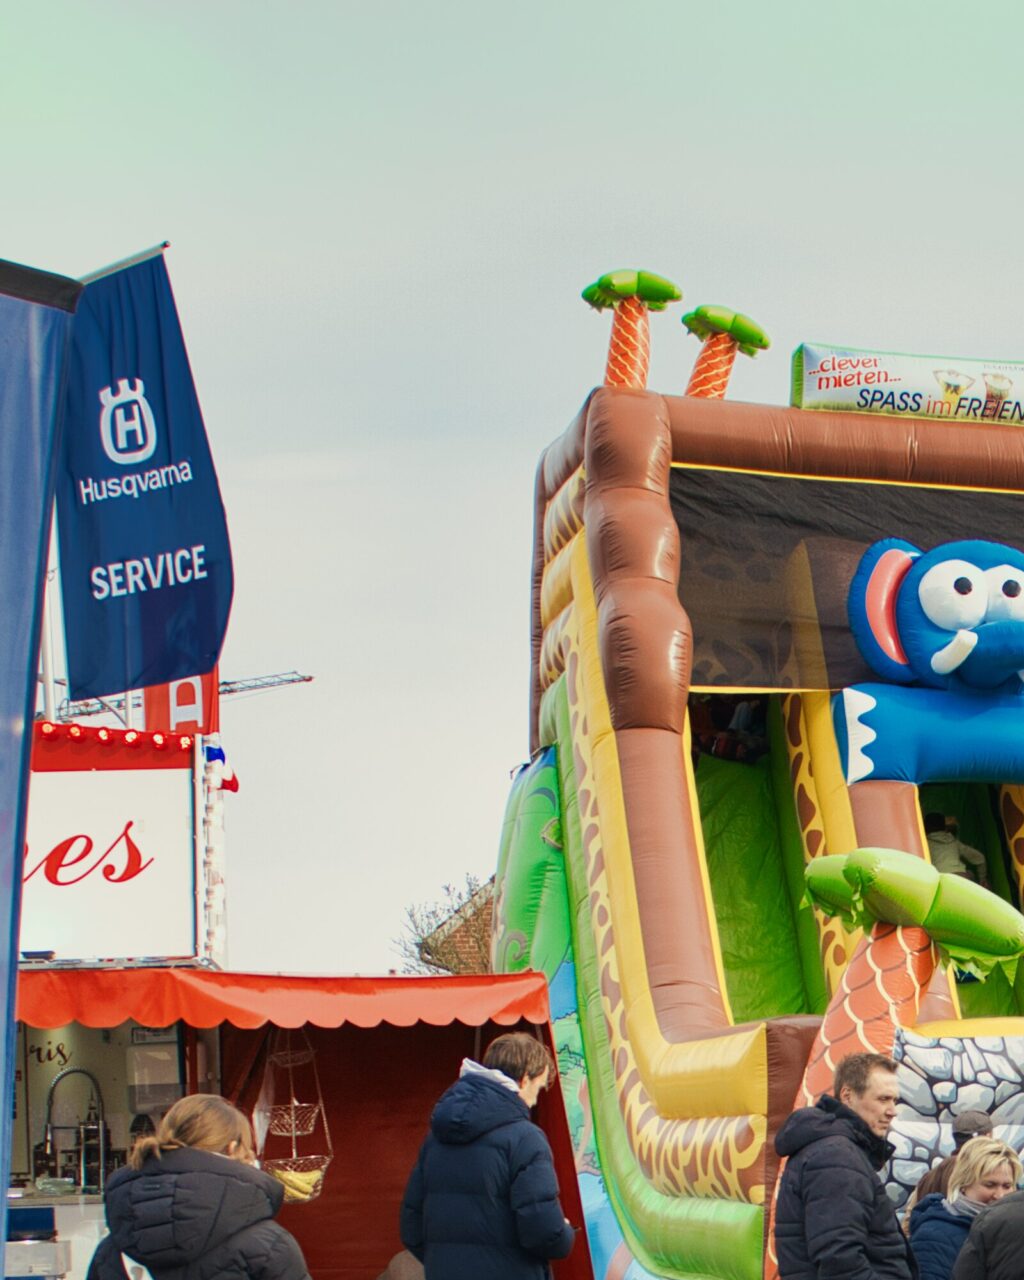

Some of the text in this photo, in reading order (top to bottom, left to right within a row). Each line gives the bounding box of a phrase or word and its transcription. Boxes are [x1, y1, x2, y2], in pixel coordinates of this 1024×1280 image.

[856, 388, 923, 412] SPASS
[926, 395, 952, 416] im
[79, 461, 193, 505] Husqvarna
[91, 545, 208, 600] SERVICE
[22, 820, 154, 887] es
